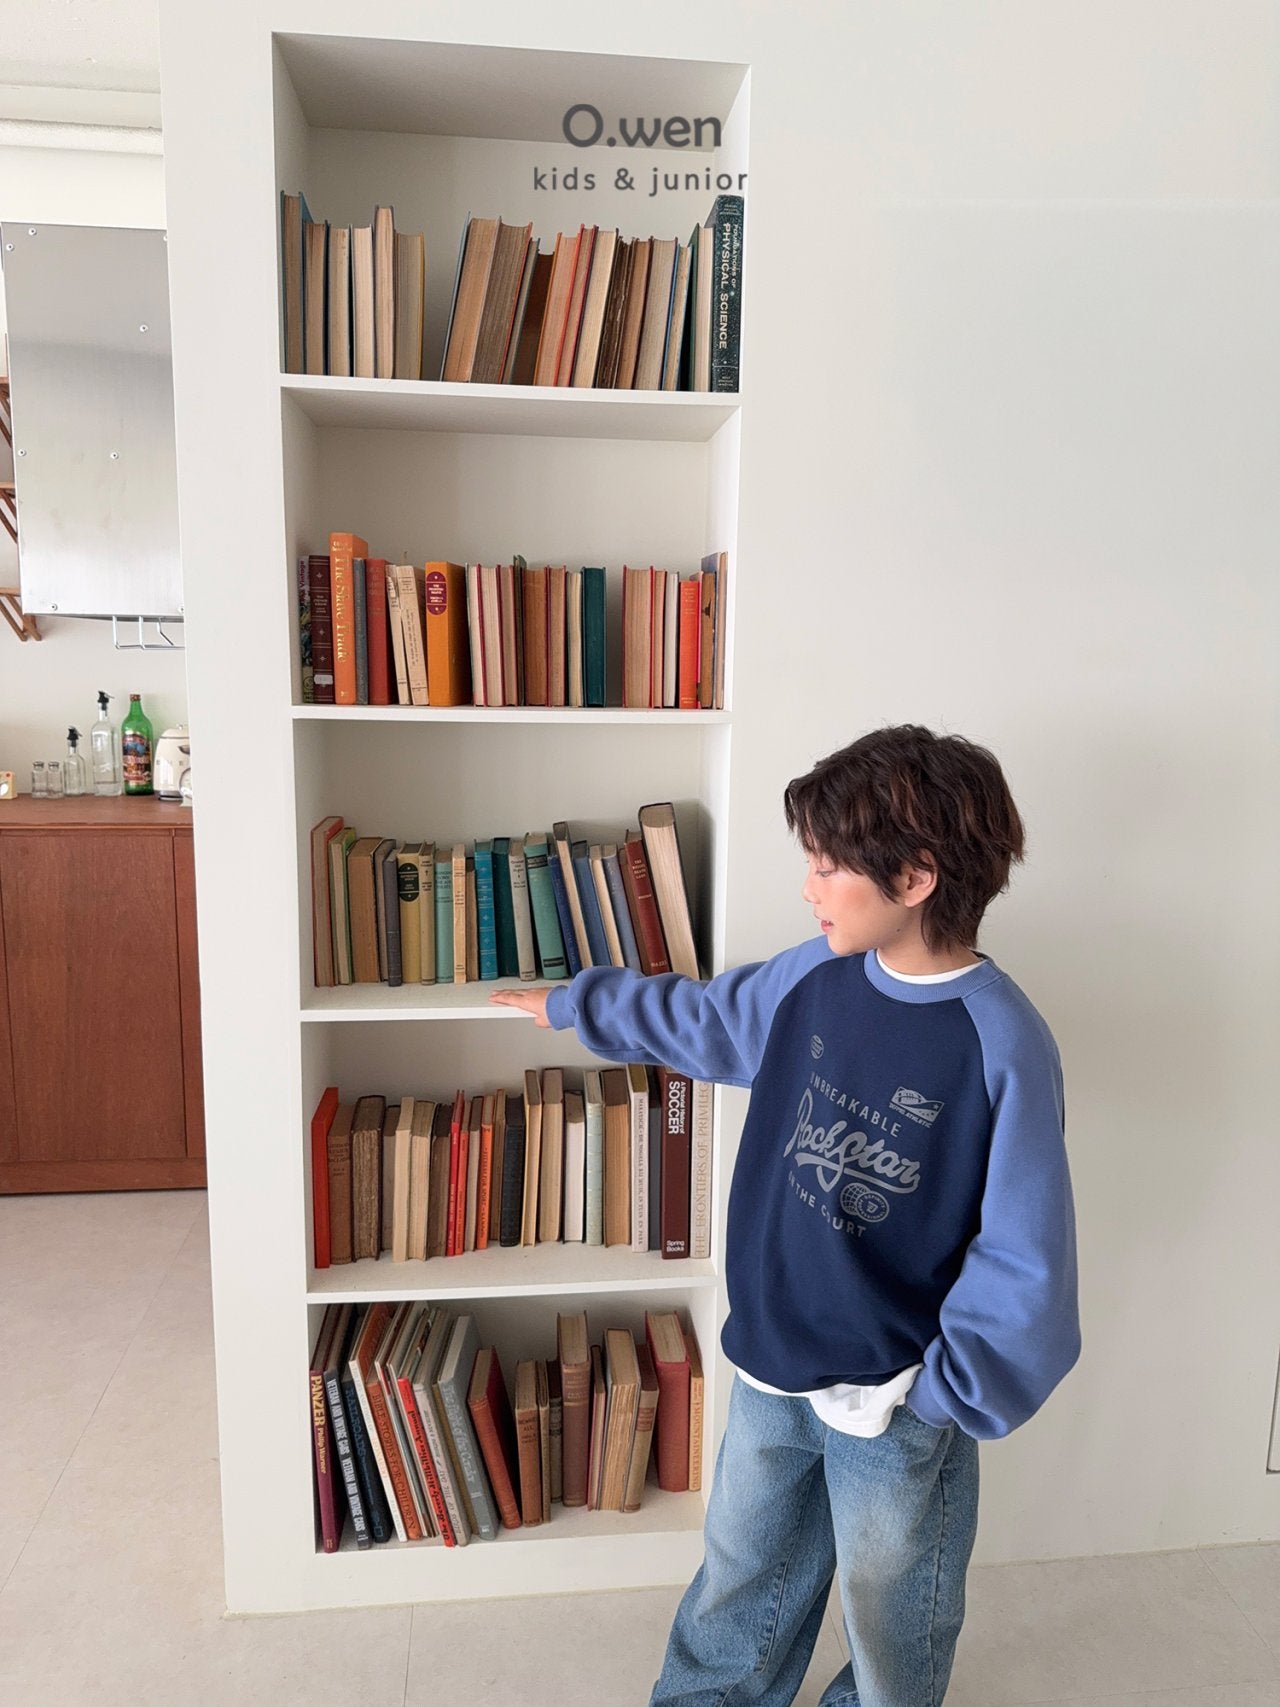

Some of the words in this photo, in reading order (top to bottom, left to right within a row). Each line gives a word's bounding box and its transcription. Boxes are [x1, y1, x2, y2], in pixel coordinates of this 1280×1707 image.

[719, 222, 731, 288] PHYSICAL
[729, 223, 739, 276] FOUNDATIONS
[730, 278, 736, 288] OF
[717, 292, 728, 349] SCIENCE
[333, 558, 349, 582] The
[336, 624, 352, 662] Trade
[667, 1080, 680, 1134] SOCCER
[696, 1141, 708, 1159] OF
[694, 1161, 707, 1226] FRONTIERS
[795, 1183, 816, 1209] THE
[694, 1231, 705, 1254] THE
[325, 1378, 340, 1405] VETERAN
[370, 1393, 385, 1420] BIBLE
[309, 1374, 325, 1426] PANZER
[318, 1447, 327, 1474] Warner
[378, 1420, 396, 1458] STORIES
[408, 1409, 424, 1444] Annual
[337, 1439, 350, 1455] CARS
[341, 1457, 355, 1482] VETERAN
[389, 1459, 402, 1479] FOR
[417, 1443, 436, 1490] Hillbillies
[395, 1480, 416, 1530] CHILDREN
[430, 1489, 446, 1523] Beverly
[352, 1516, 365, 1532] CARS
[439, 1523, 450, 1540] The
